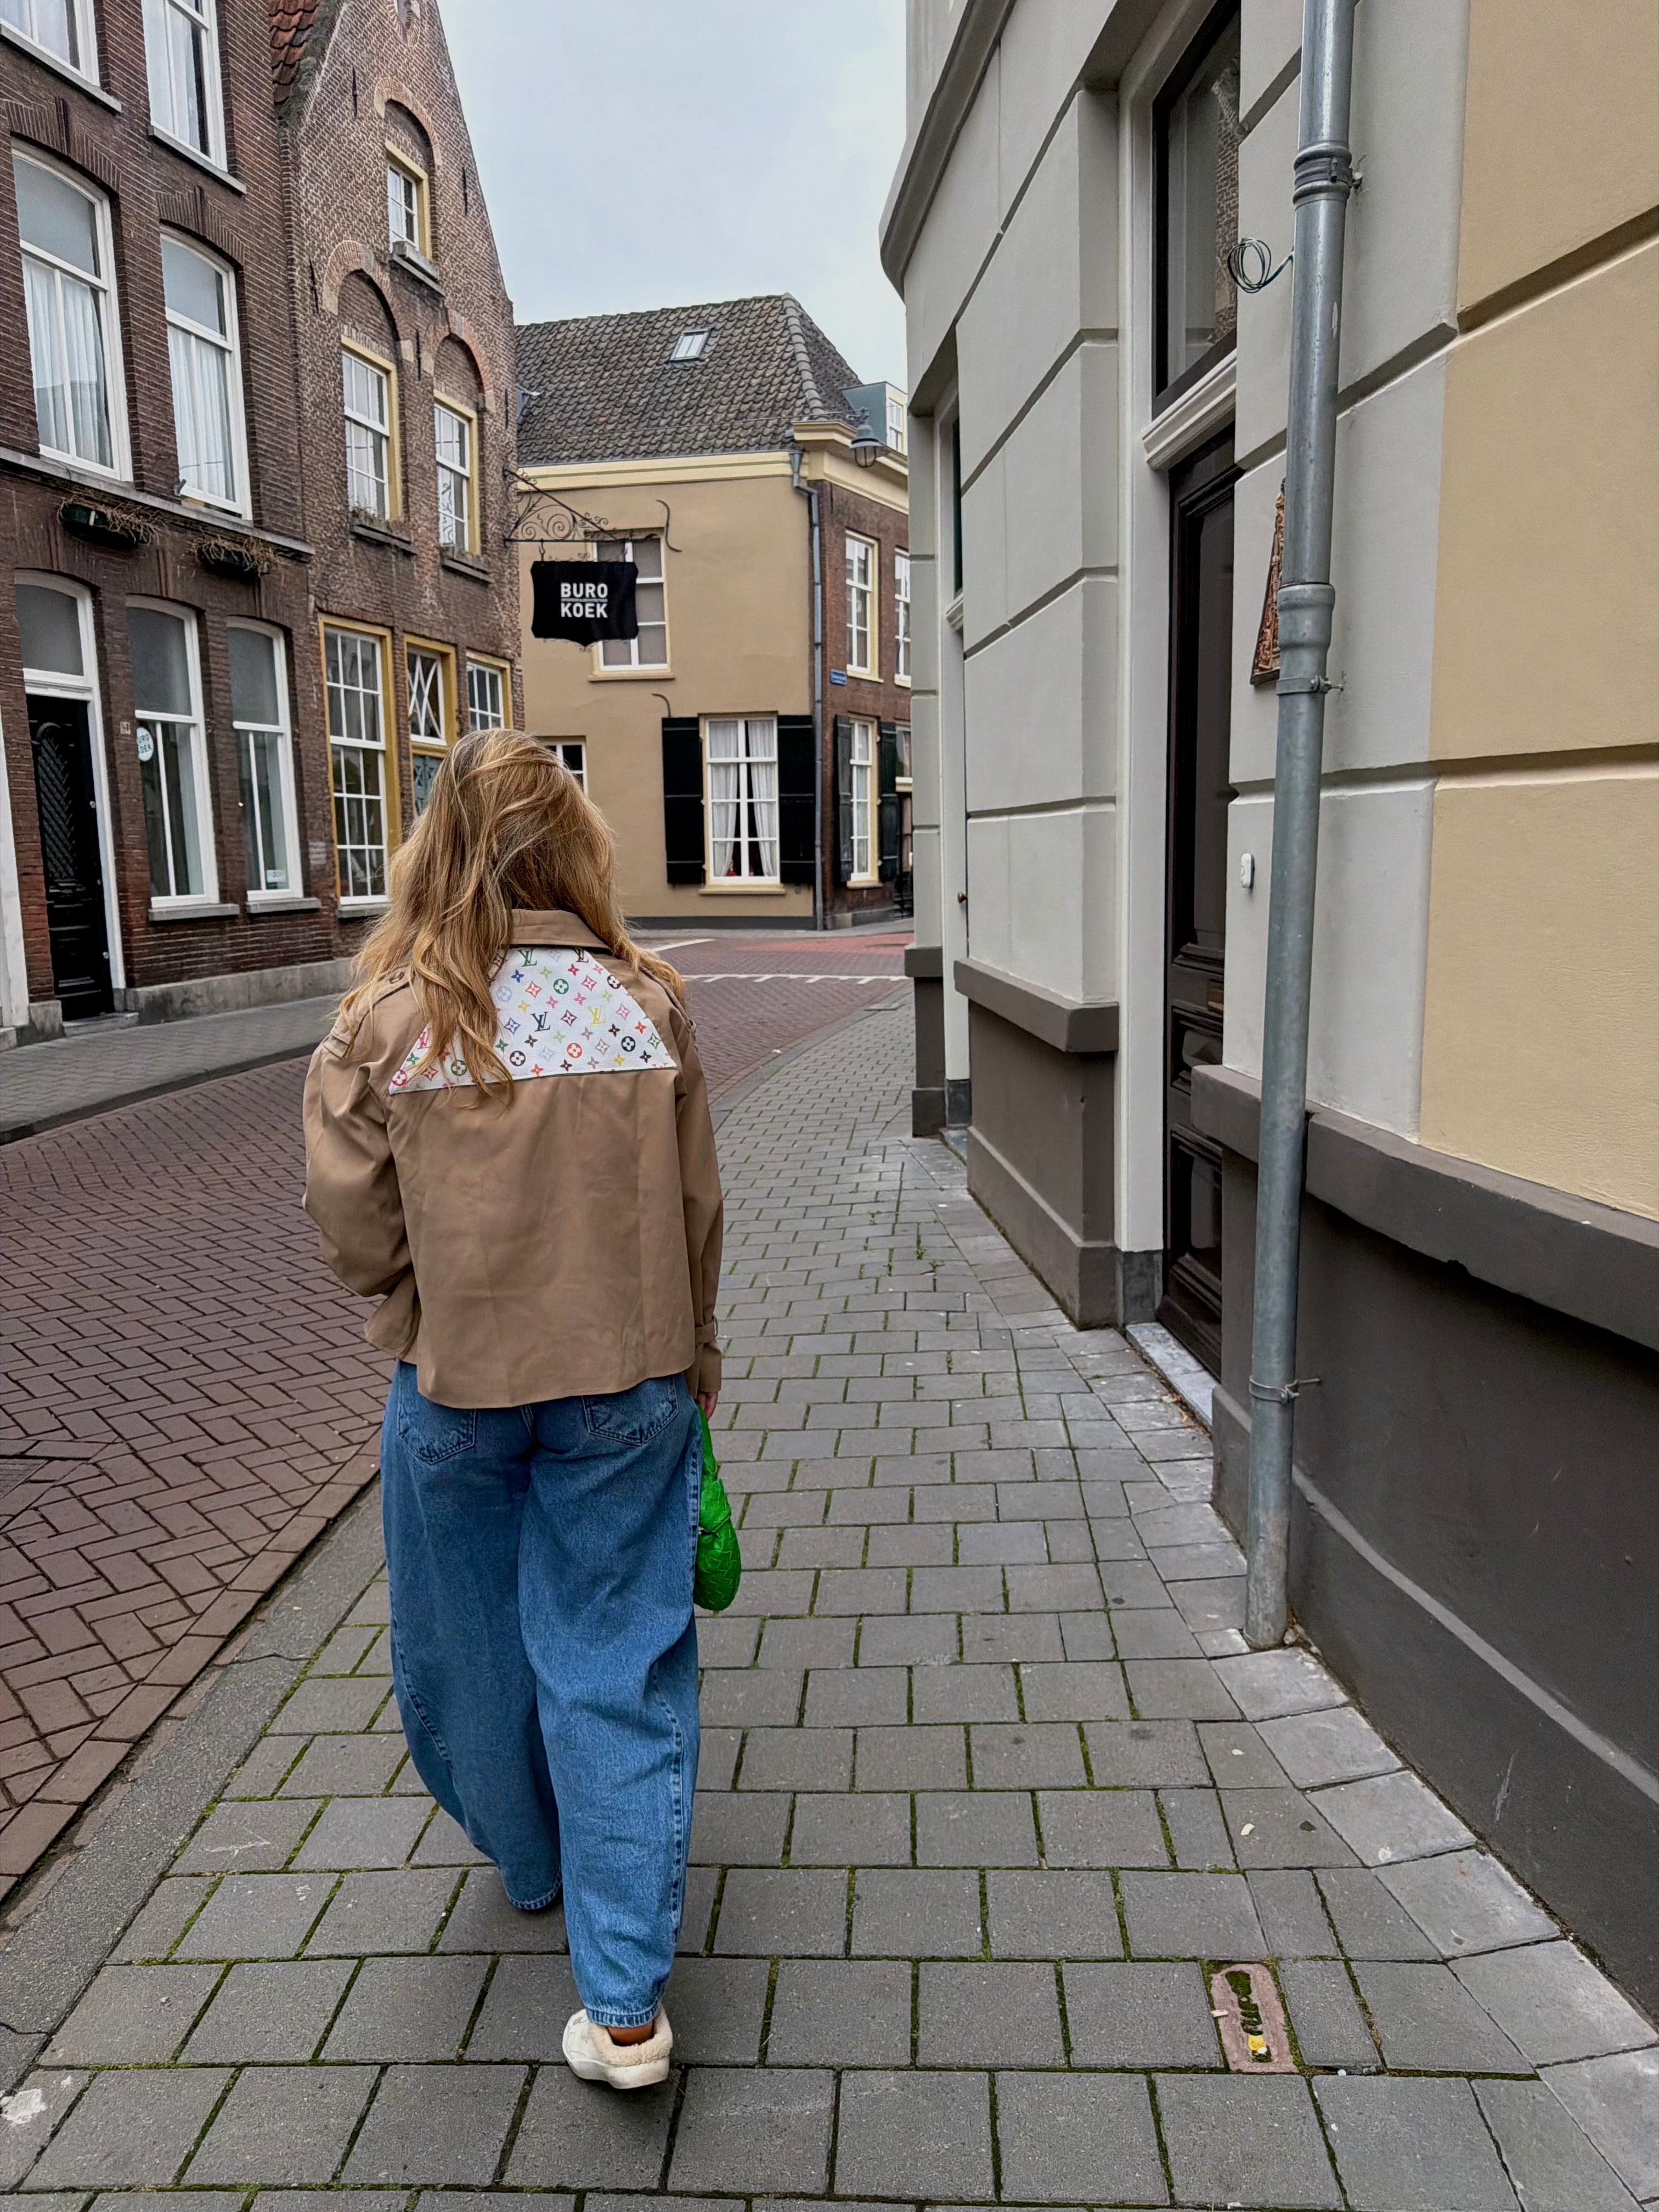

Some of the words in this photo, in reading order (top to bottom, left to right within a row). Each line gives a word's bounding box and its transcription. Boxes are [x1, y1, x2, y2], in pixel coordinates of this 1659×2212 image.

[561, 583, 608, 598] BURO
[561, 603, 608, 618] KOEK
[137, 733, 150, 743] URO
[139, 744, 152, 753] OEK
